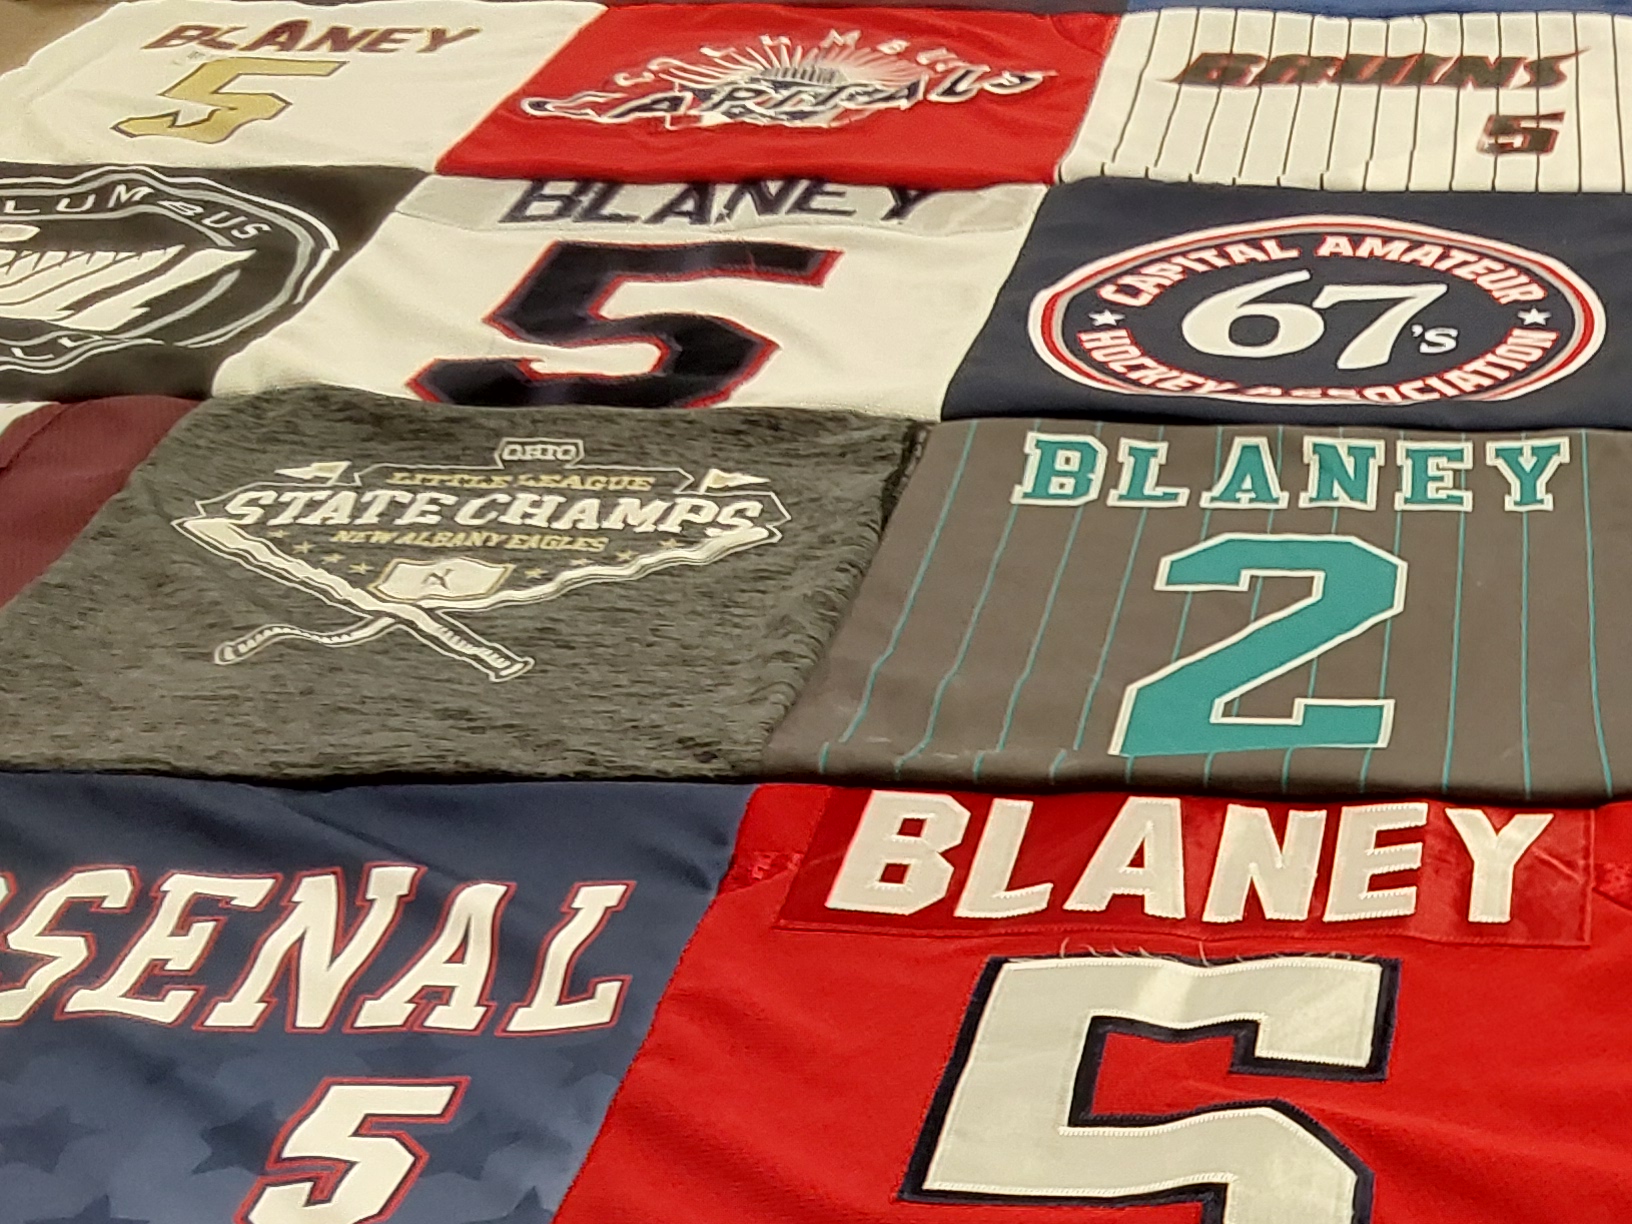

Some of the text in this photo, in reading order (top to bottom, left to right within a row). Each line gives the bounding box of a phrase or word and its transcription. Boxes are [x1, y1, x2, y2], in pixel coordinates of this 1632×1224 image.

[141, 19, 482, 55] BLANEY
[1155, 46, 1592, 90] BRUINS
[110, 58, 349, 145] 5
[1475, 110, 1566, 155] 5
[498, 178, 934, 224] BLANEY
[1096, 234, 1549, 307] CAPITAL AMATEUR
[406, 240, 843, 408] 5
[1076, 327, 1241, 394] HOCKEY
[502, 444, 577, 461] OHIO
[1011, 431, 1570, 512] BLANEY
[386, 472, 657, 491] LITTLE LEAGUE
[224, 489, 765, 536] STATE CHAMPS
[331, 529, 610, 551] NEW ALBANY EAGLES
[1108, 532, 1409, 757] 2
[825, 790, 1554, 924] BLANEY
[0, 861, 637, 1037] SENAL
